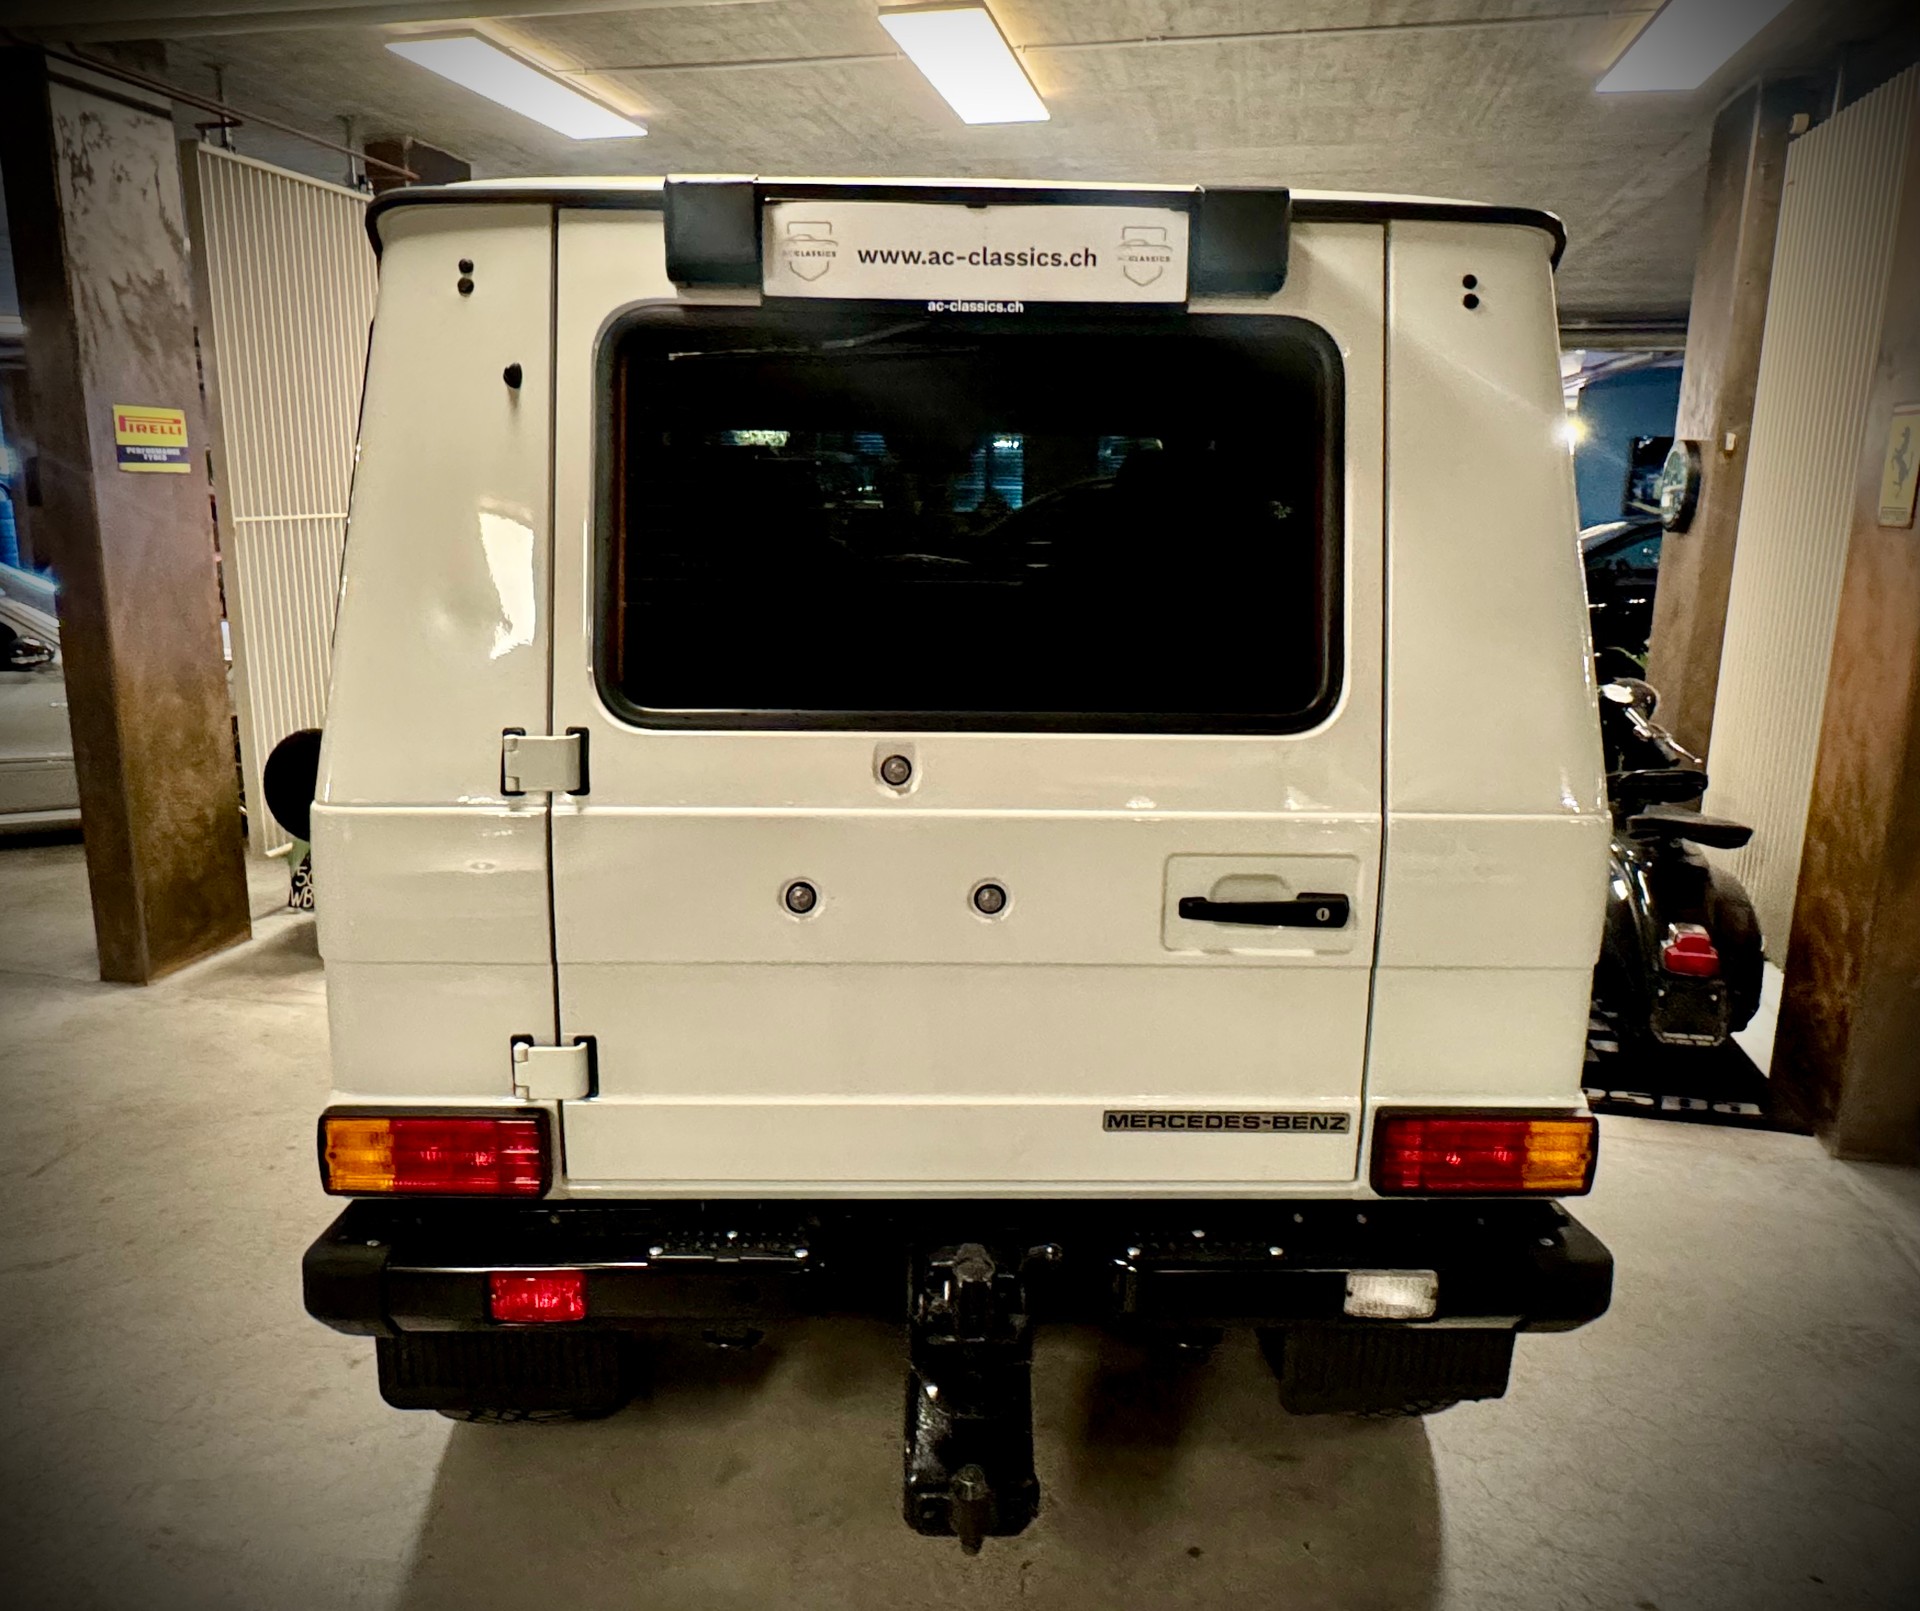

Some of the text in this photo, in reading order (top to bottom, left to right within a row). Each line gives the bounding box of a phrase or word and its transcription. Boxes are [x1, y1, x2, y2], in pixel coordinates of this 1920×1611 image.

[857, 246, 1098, 268] www.ac-classics.ch
[927, 300, 1025, 314] ac-classics.ch
[118, 414, 183, 436] PIRELLI
[1106, 1113, 1347, 1131] MERCEDES-BENZ
